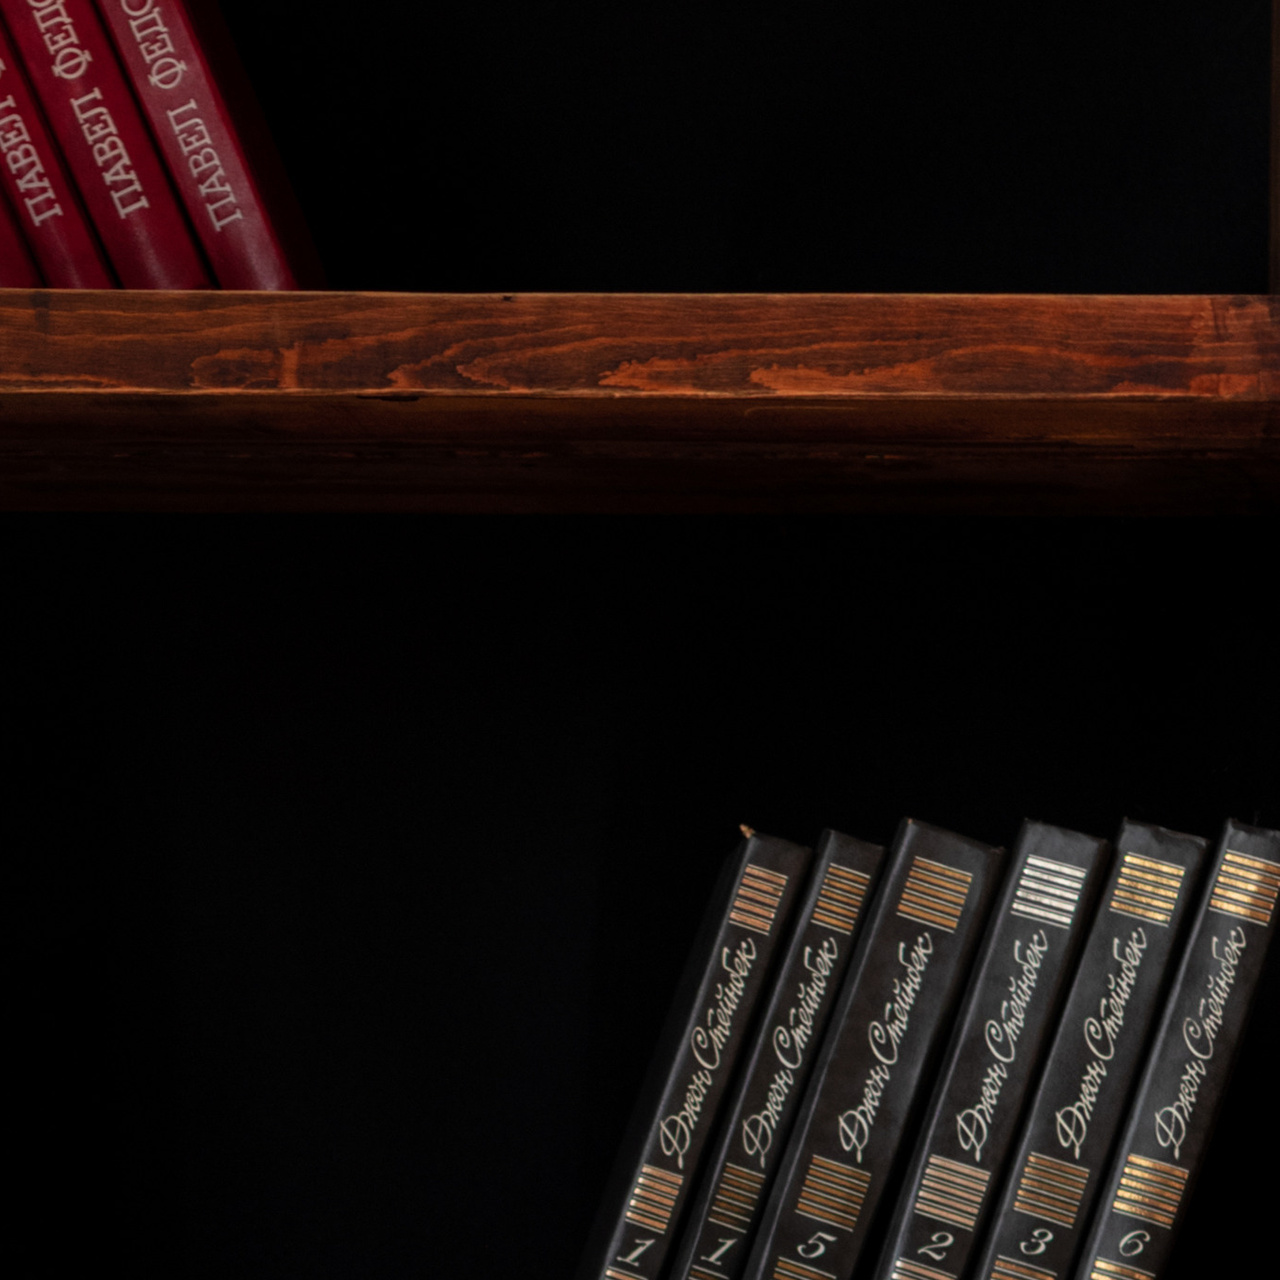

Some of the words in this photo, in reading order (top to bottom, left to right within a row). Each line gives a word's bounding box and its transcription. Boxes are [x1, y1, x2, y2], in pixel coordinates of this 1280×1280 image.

[70, 87, 150, 220] ПАВЕЛ
[166, 98, 243, 232] ПАВЕЛ
[660, 1067, 712, 1169] Джон
[691, 937, 759, 1070] Стейнбек
[742, 1067, 795, 1169] Джон
[774, 937, 840, 1070] Стейнбек
[838, 1064, 891, 1164] Джон
[868, 931, 934, 1065] Стейнбек
[956, 1060, 1009, 1163] Джон
[984, 929, 1049, 1063] Стейнбек
[1055, 1060, 1108, 1160] Джон
[1084, 926, 1149, 1062] Стейнбек
[1154, 1059, 1207, 1160] Джон
[1183, 925, 1247, 1061] Стейнбек
[617, 1238, 655, 1267] 1
[701, 1238, 738, 1266] 1
[797, 1232, 838, 1259] 5
[918, 1232, 954, 1261] 2
[1021, 1229, 1054, 1256] 3
[1119, 1230, 1151, 1257] 6
